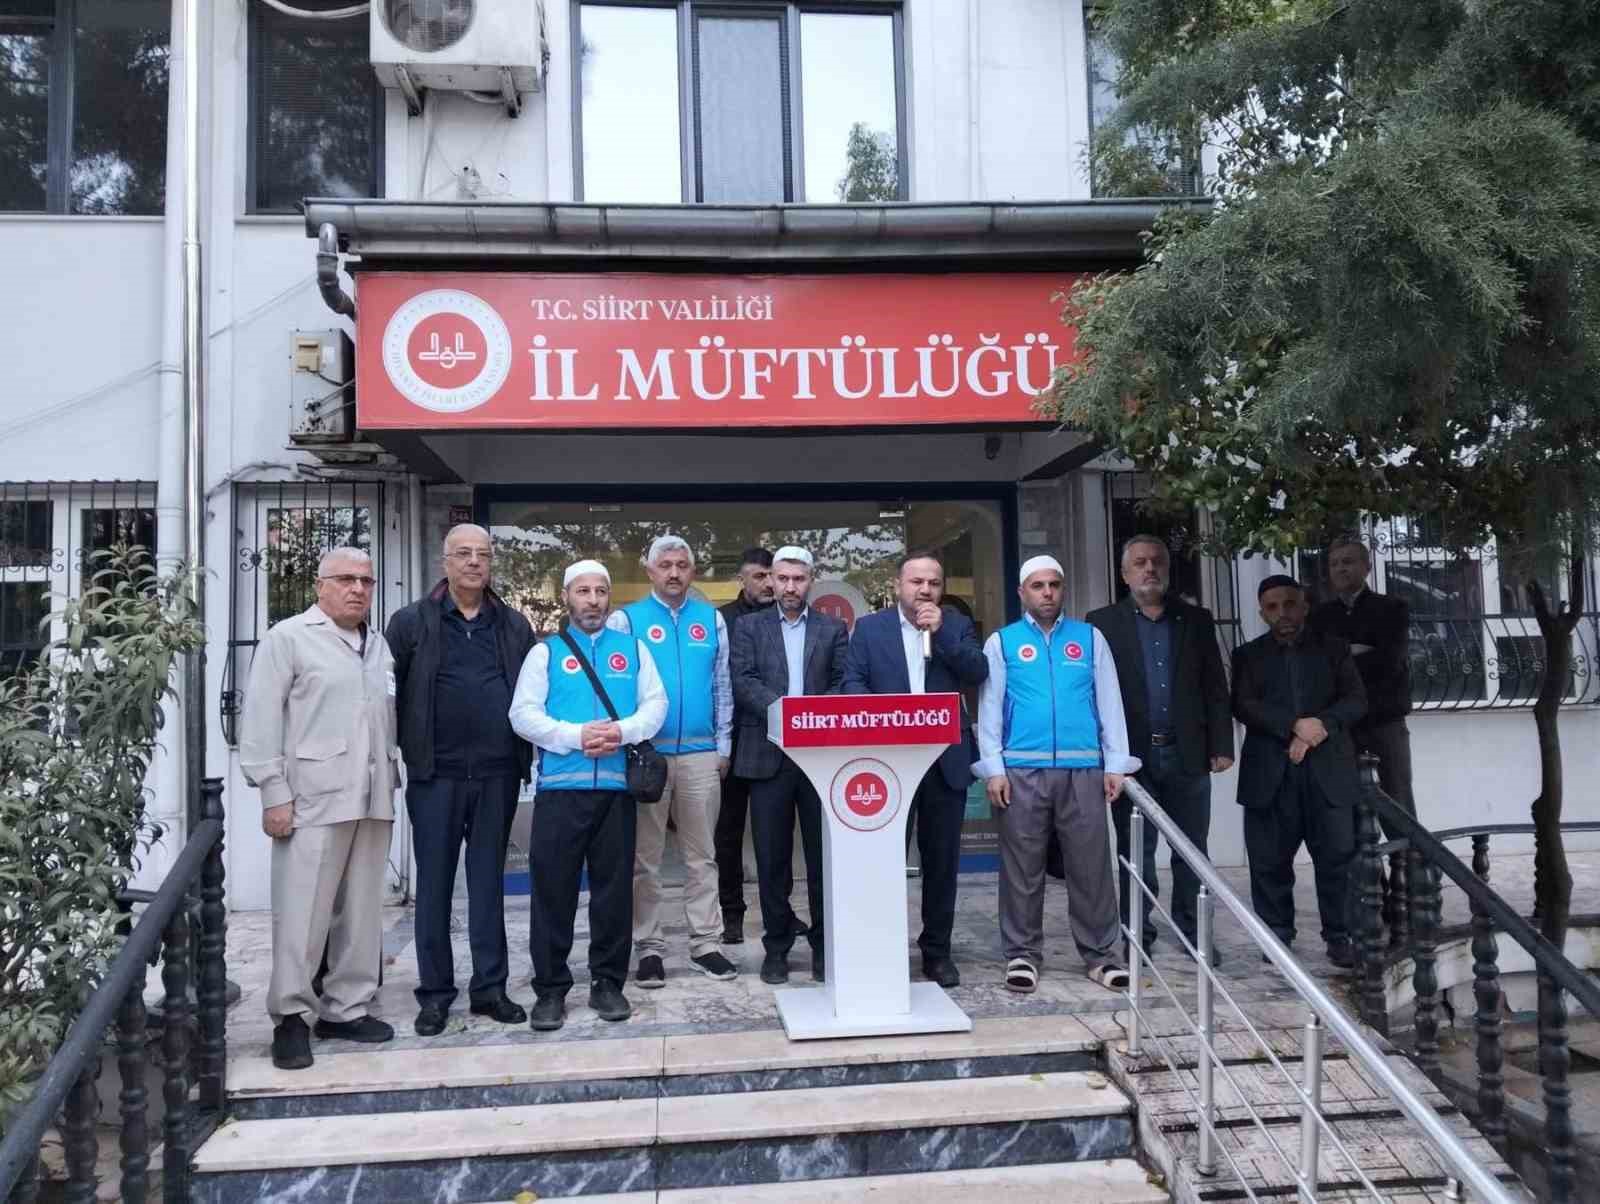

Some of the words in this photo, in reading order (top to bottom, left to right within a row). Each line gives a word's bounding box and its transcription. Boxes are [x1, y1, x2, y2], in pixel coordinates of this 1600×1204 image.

[530, 299, 578, 321] T.C.
[582, 295, 654, 321] SİİRT
[658, 295, 774, 321] VALİLİĞİ
[528, 335, 600, 401] İL
[613, 333, 1060, 401] MÜFTÜLÜĞÜ
[791, 711, 839, 730] SİİRT
[841, 709, 952, 729] MÜFTÜLÜĞÜ
